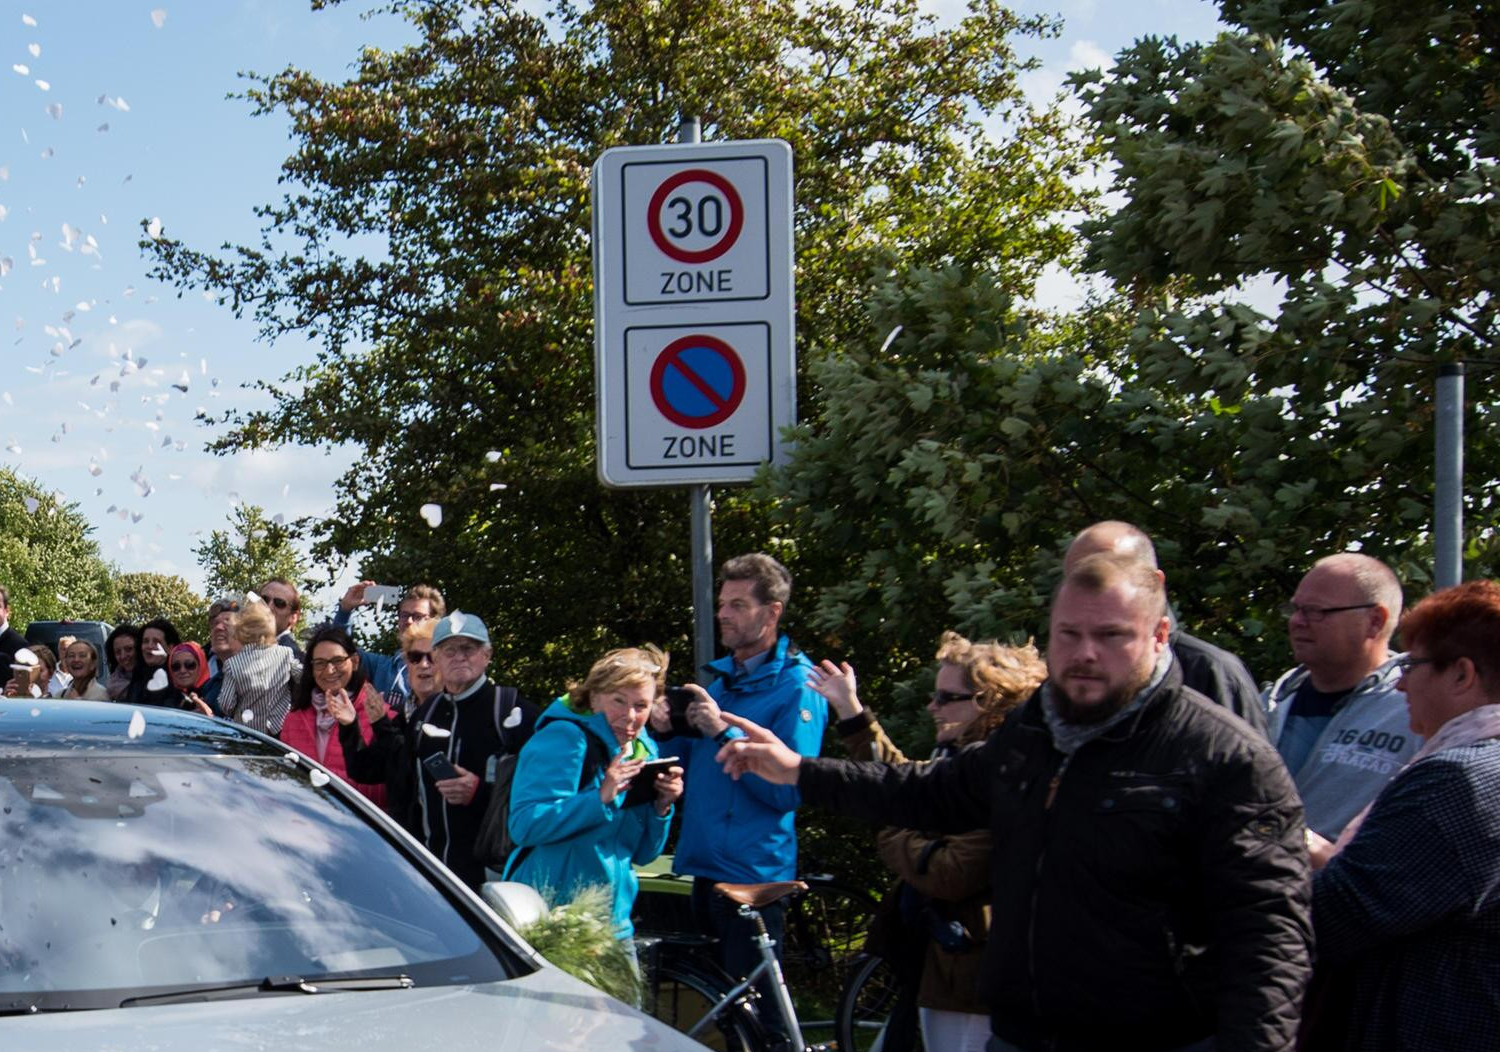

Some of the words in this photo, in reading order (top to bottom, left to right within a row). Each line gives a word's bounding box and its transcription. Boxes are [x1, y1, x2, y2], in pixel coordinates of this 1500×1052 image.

[667, 195, 723, 239] 30
[660, 269, 733, 295] ZONE
[663, 434, 736, 459] ZONE
